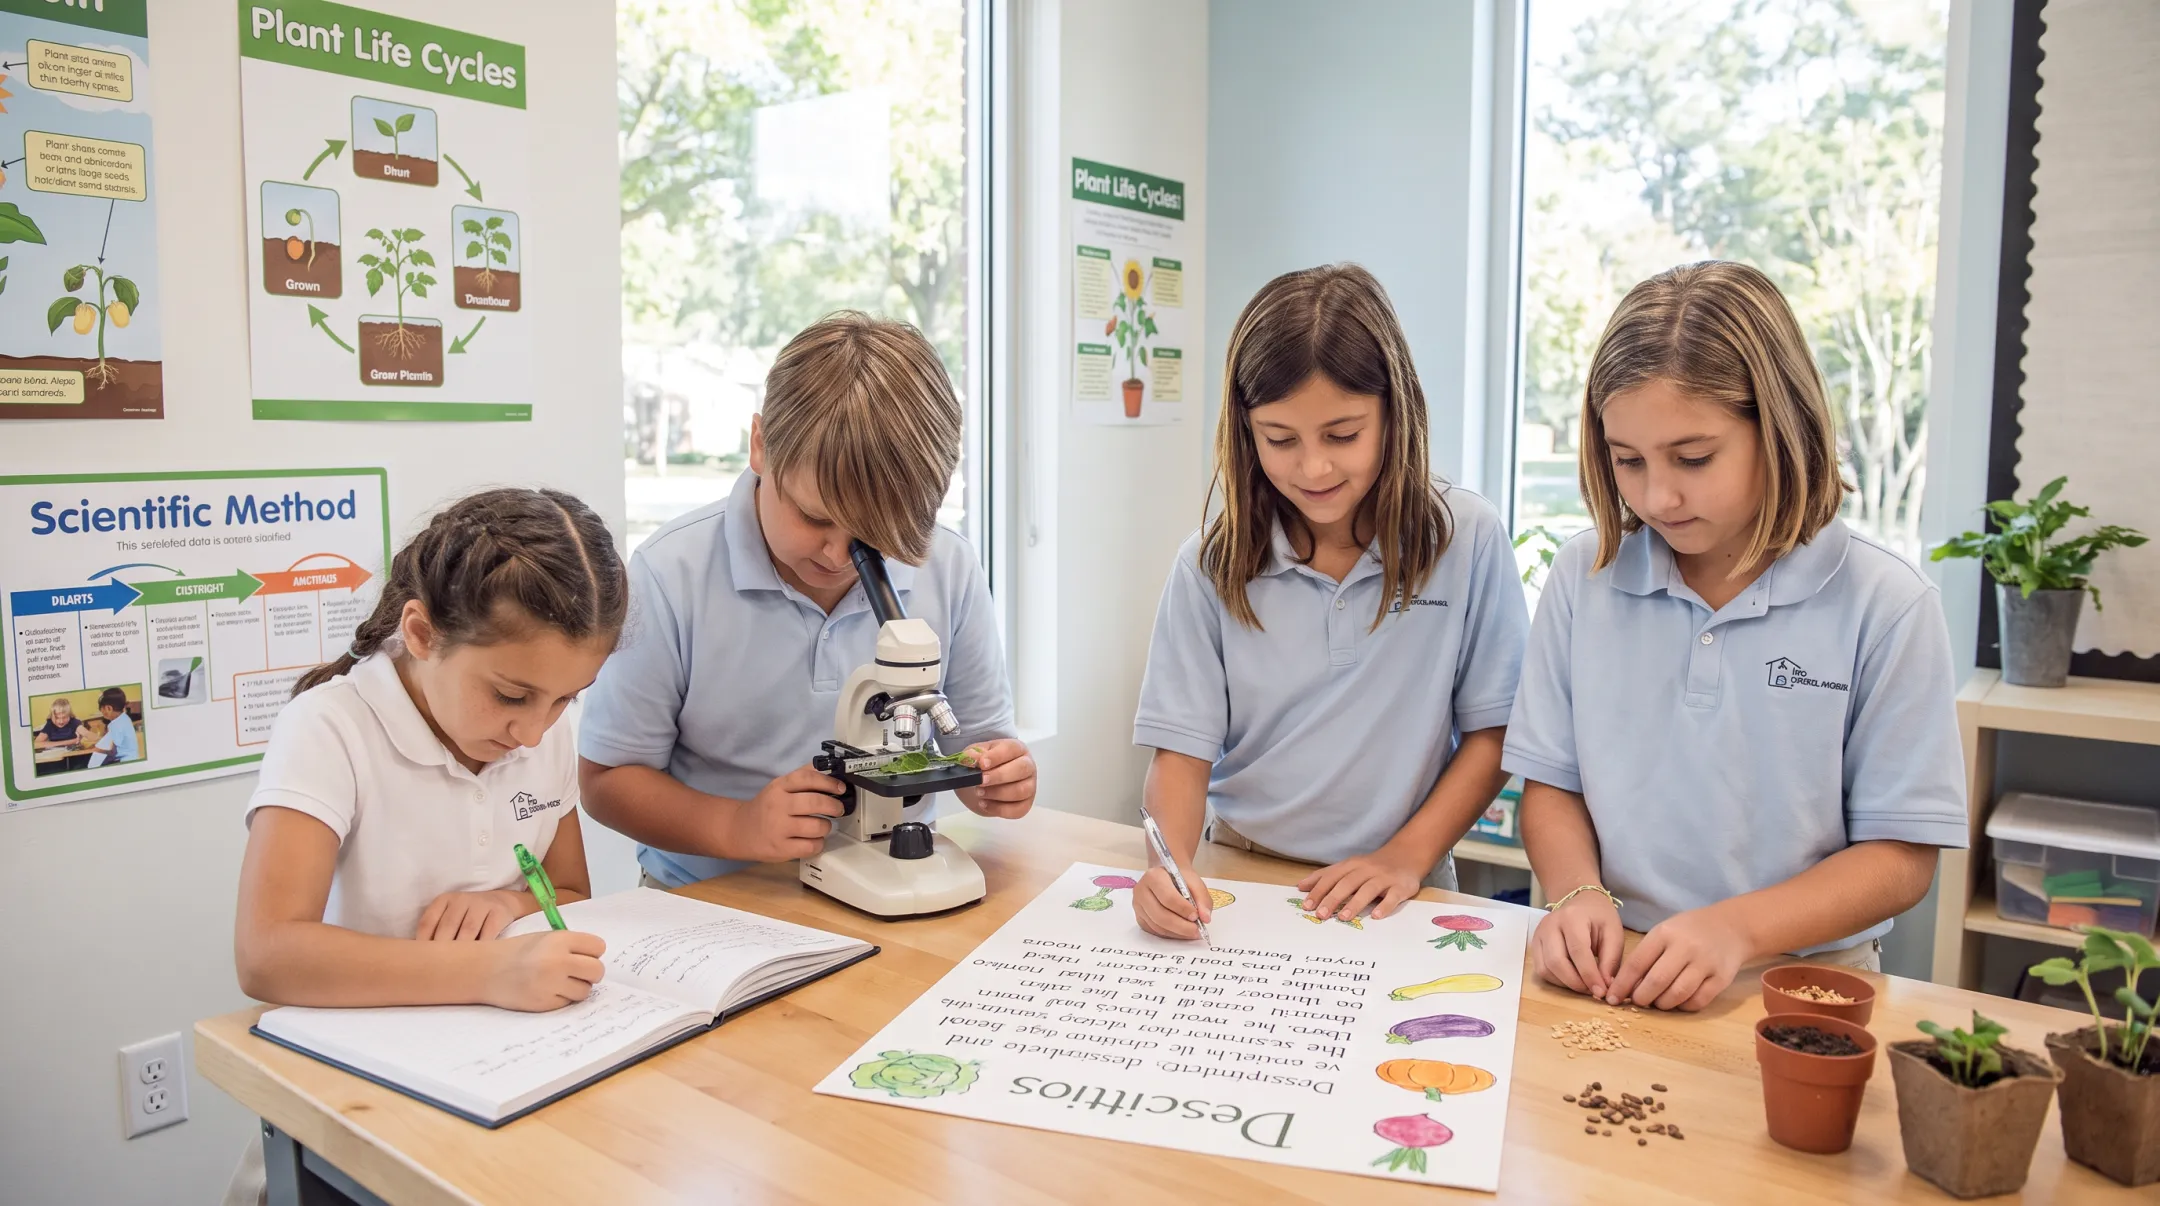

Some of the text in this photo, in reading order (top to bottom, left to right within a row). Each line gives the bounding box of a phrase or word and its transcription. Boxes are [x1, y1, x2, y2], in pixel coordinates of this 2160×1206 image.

[251, 6, 518, 90] Plant Life Cycles
[64, 155, 82, 164] and
[1074, 168, 1111, 195] Plant
[1112, 176, 1137, 201] Life
[285, 279, 321, 293] Grown
[30, 489, 357, 536] Scientific Method
[116, 540, 138, 551] This
[188, 537, 211, 548] data
[213, 535, 221, 545] is
[945, 1034, 994, 1046] and
[1307, 1043, 1346, 1059] the
